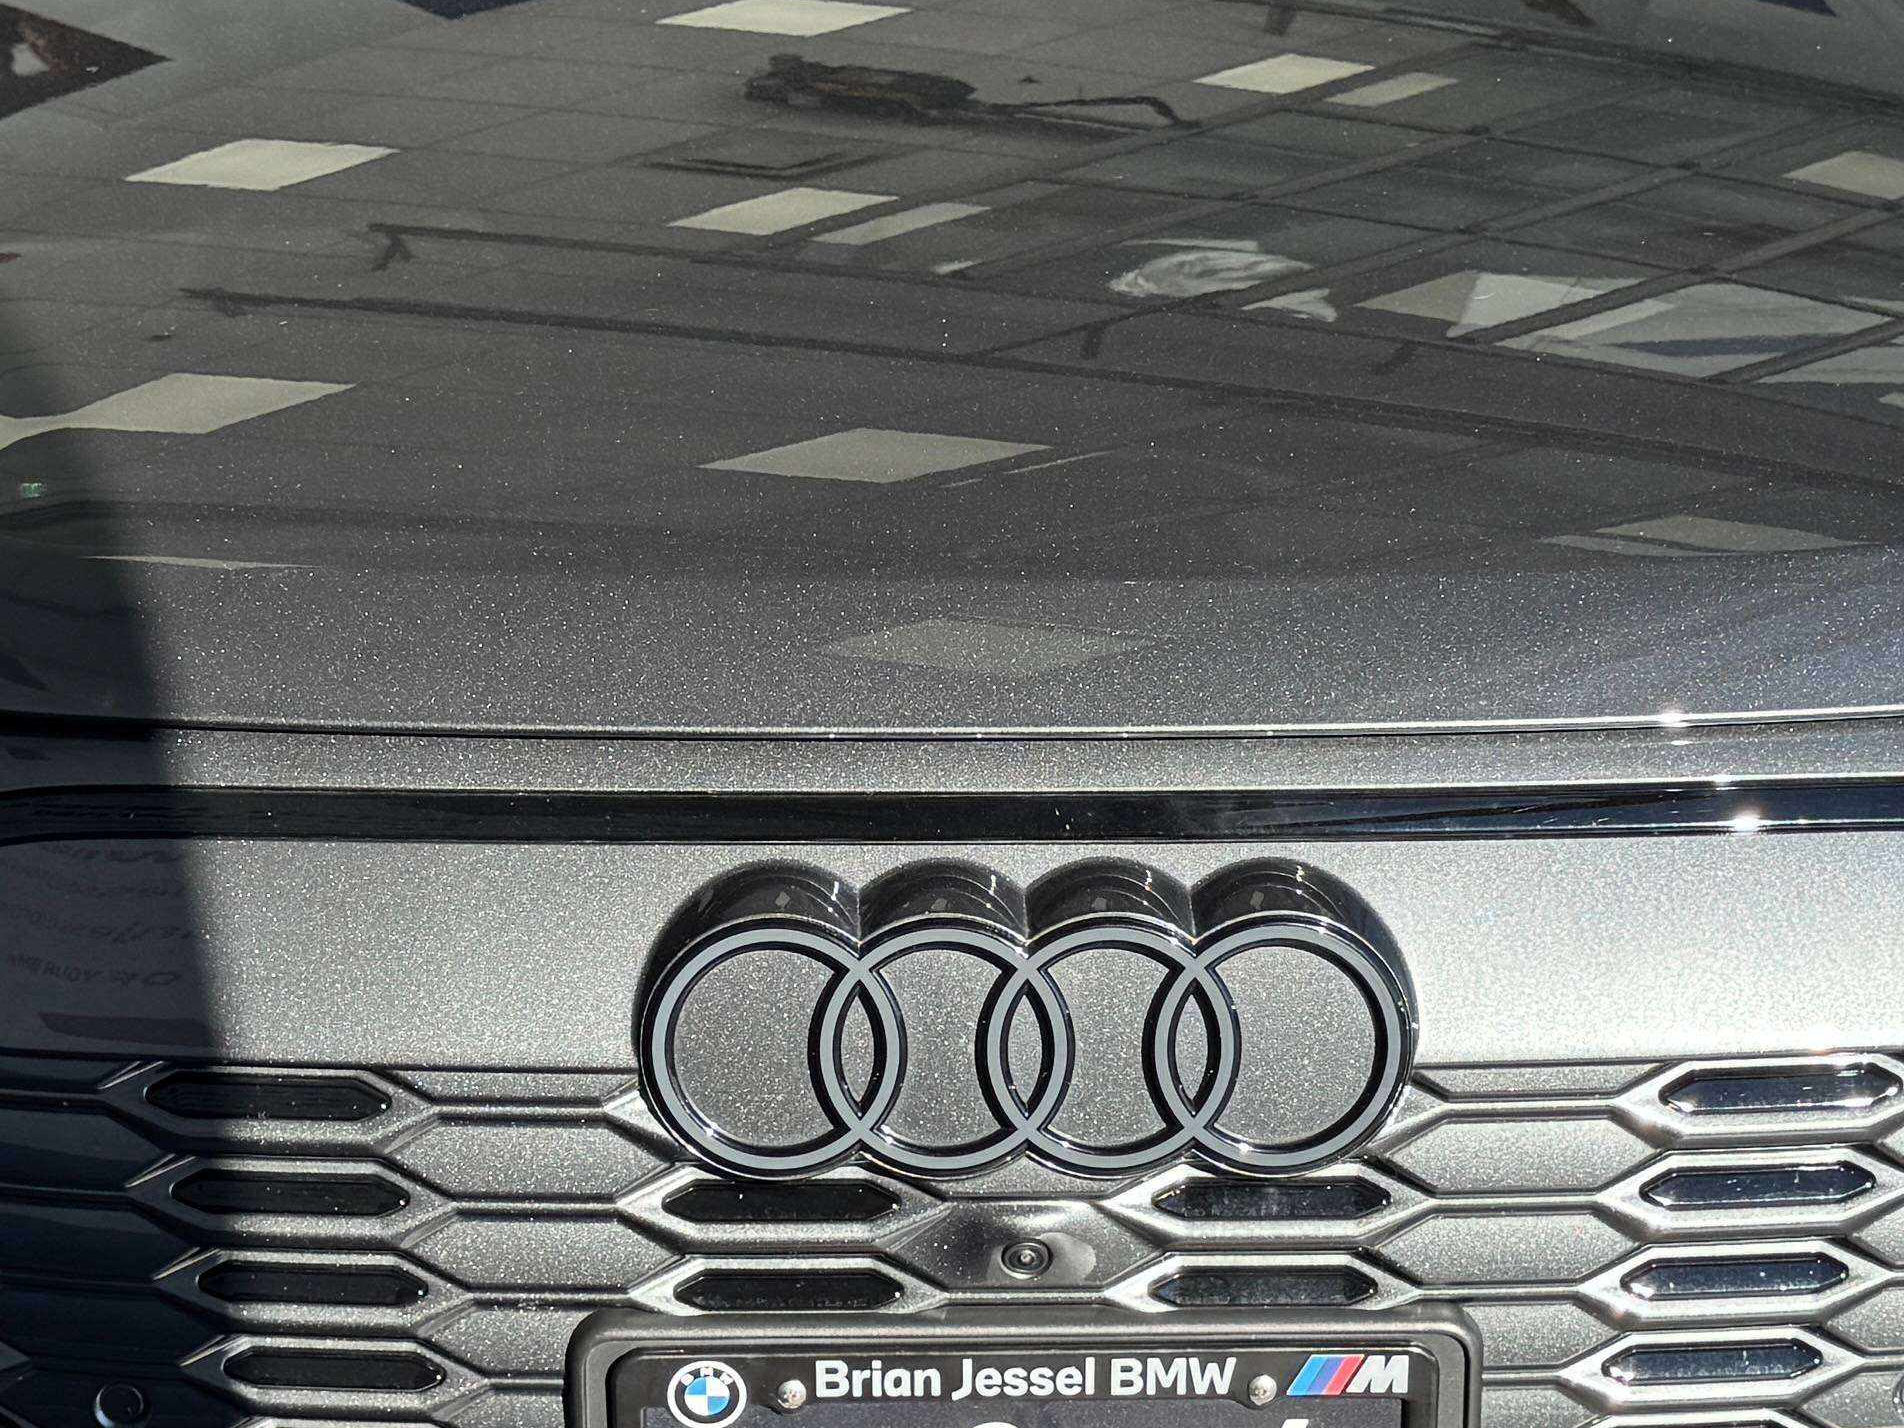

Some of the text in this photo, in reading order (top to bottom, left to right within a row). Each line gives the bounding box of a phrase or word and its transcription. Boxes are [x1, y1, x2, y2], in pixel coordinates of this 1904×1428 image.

[814, 1356, 1237, 1401] Brian Jessel BMW
